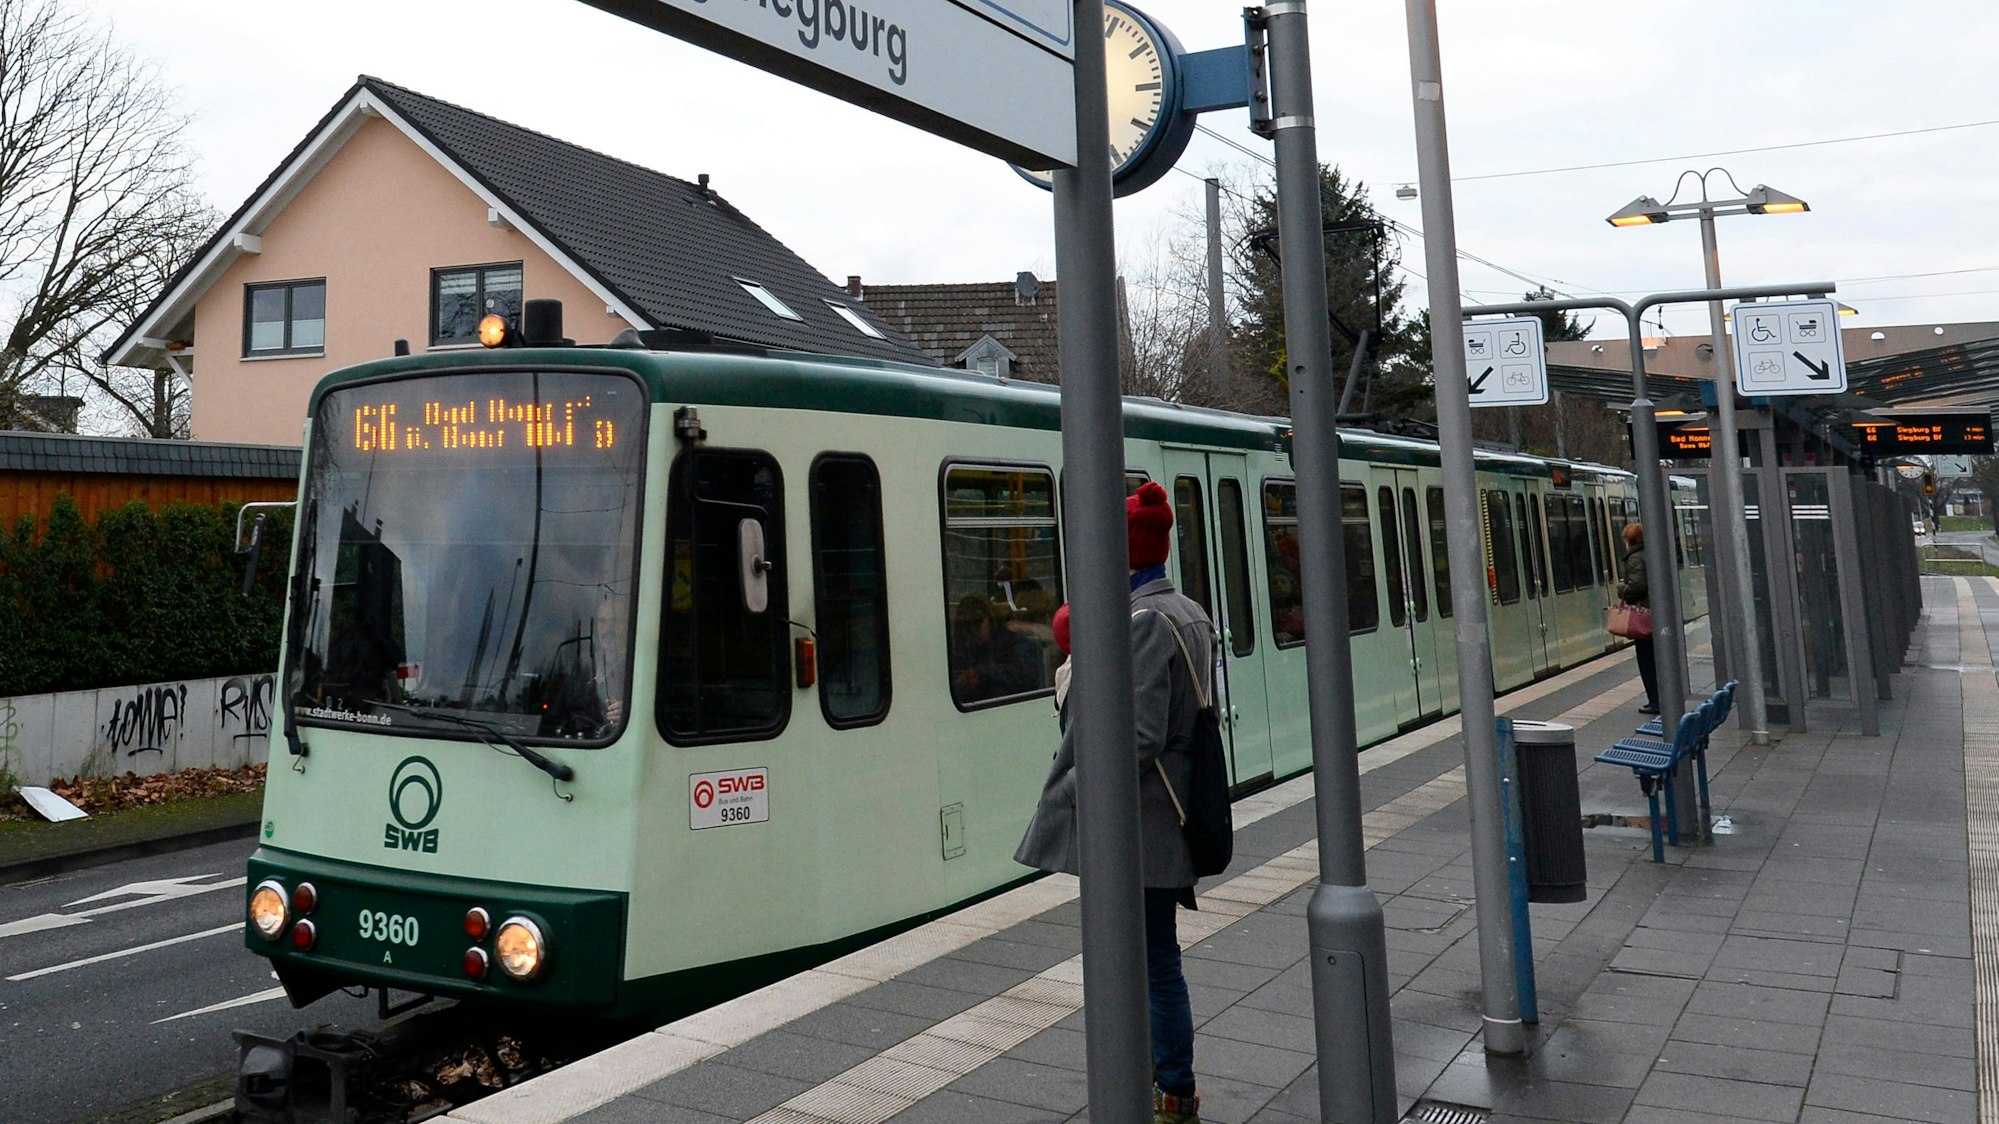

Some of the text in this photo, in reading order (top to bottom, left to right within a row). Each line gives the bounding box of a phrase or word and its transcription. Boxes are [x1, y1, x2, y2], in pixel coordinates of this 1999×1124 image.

[743, 0, 907, 86] gburg
[718, 775, 764, 794] SWB
[721, 806, 751, 823] 9360
[384, 823, 440, 854] SWB
[359, 909, 420, 947] 9360
[383, 951, 393, 964] A
